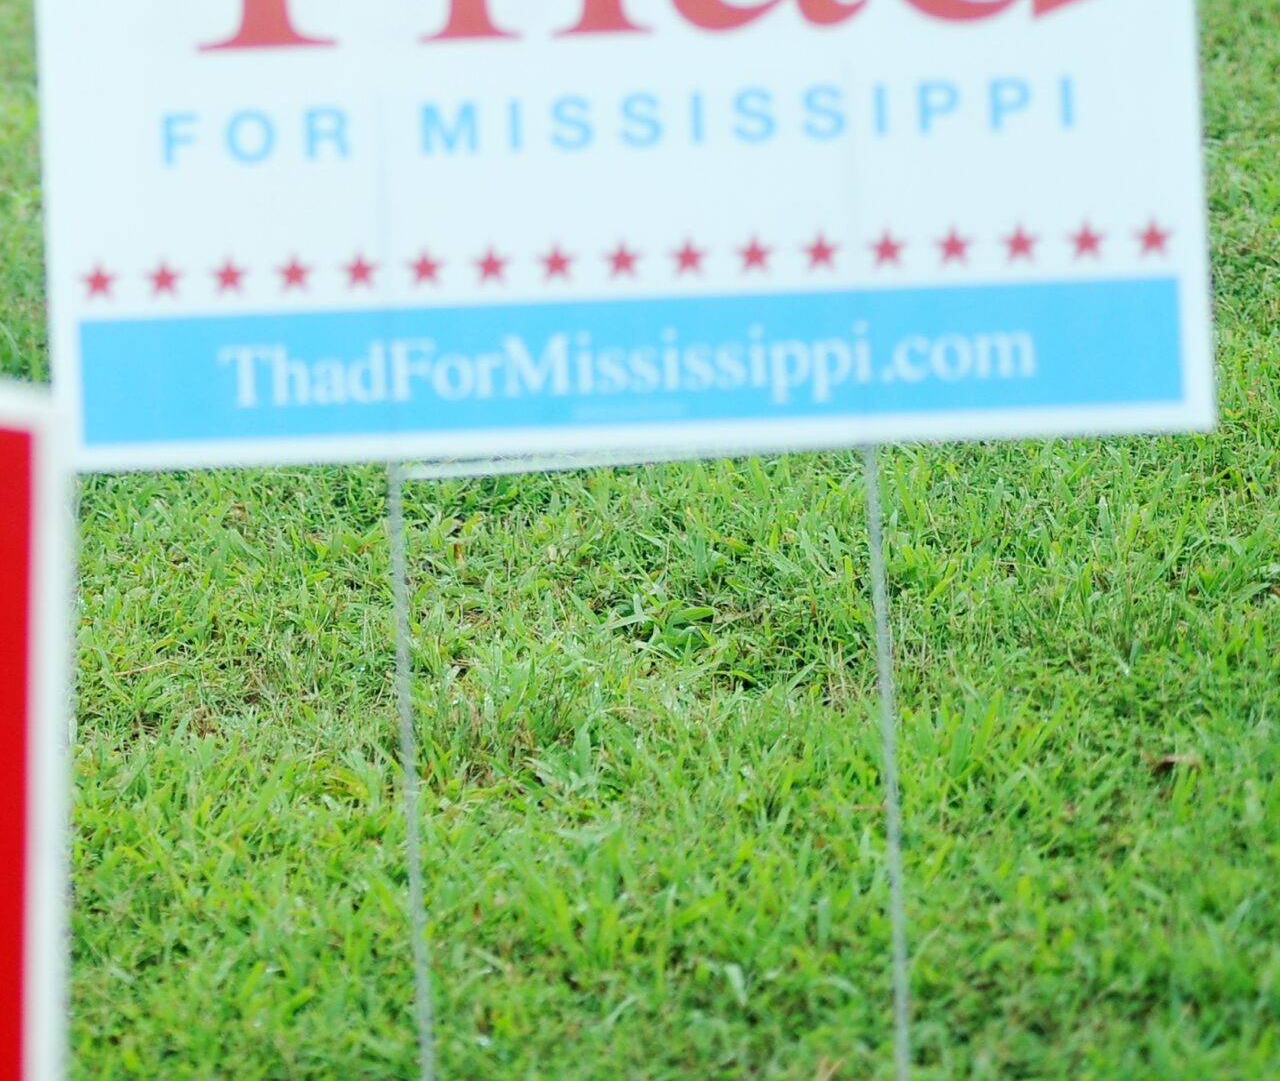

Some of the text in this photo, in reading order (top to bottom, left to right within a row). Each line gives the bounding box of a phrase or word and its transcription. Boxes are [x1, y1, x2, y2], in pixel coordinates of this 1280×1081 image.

[160, 73, 1080, 166] FOR MISSISSIPPI
[218, 321, 1039, 409] ThadForMississippi.com
